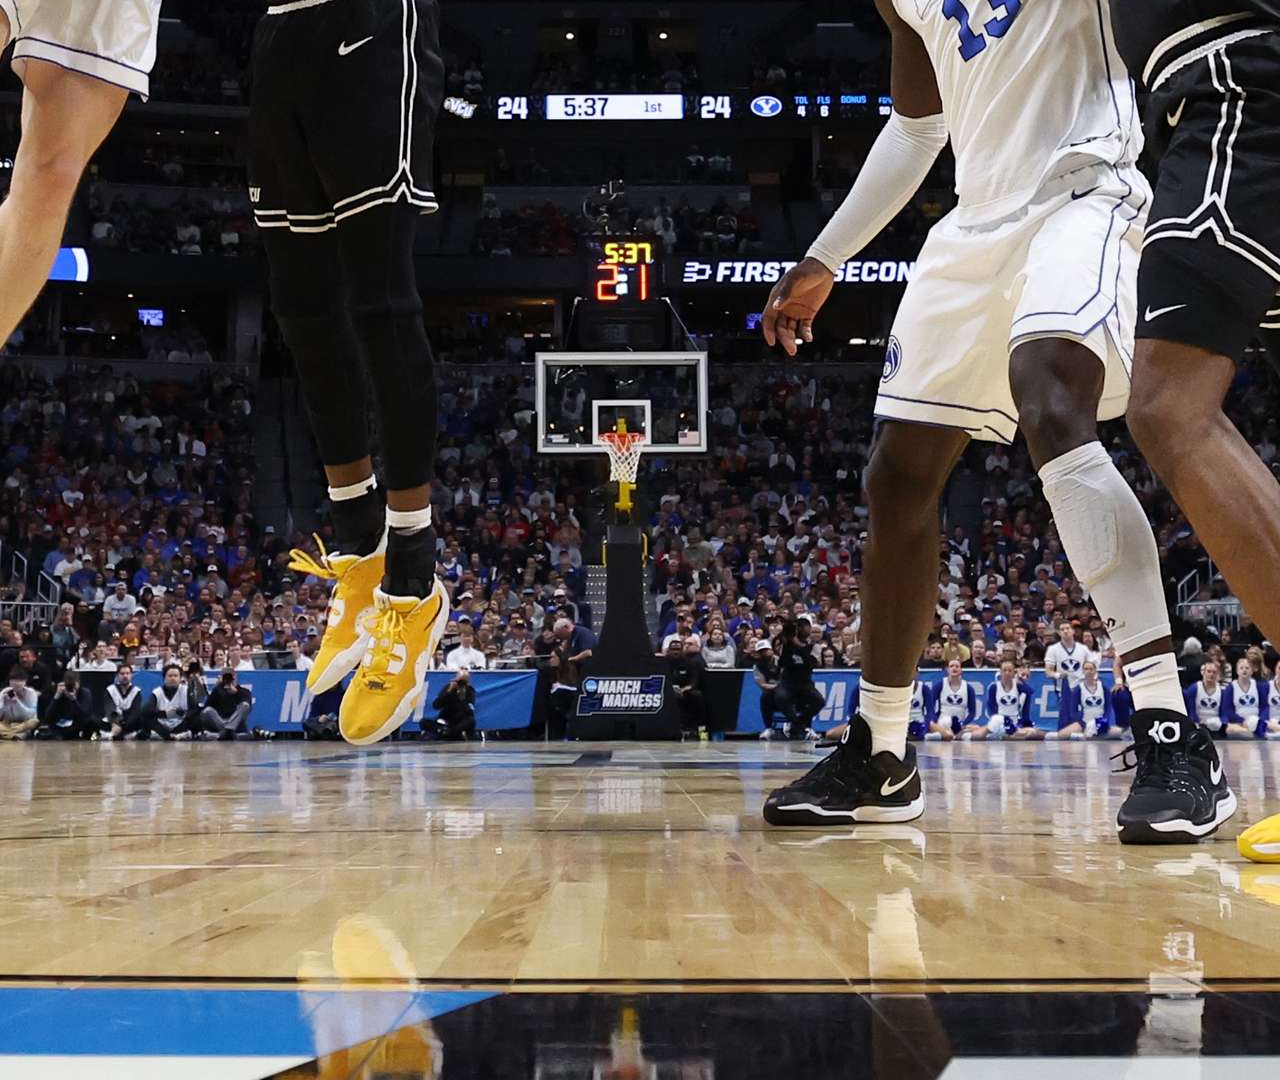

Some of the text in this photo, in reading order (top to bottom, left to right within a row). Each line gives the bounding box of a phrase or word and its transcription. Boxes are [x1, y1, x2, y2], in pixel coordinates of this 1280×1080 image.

[840, 95, 867, 105] BONUS
[497, 96, 529, 120] 24
[564, 97, 609, 117] 5:37
[643, 101, 663, 114] 1st
[700, 96, 732, 119] 24
[797, 106, 806, 118] 4
[604, 242, 653, 264] 5:37
[597, 680, 642, 694] MARCH
[601, 693, 662, 708] MADNESS
